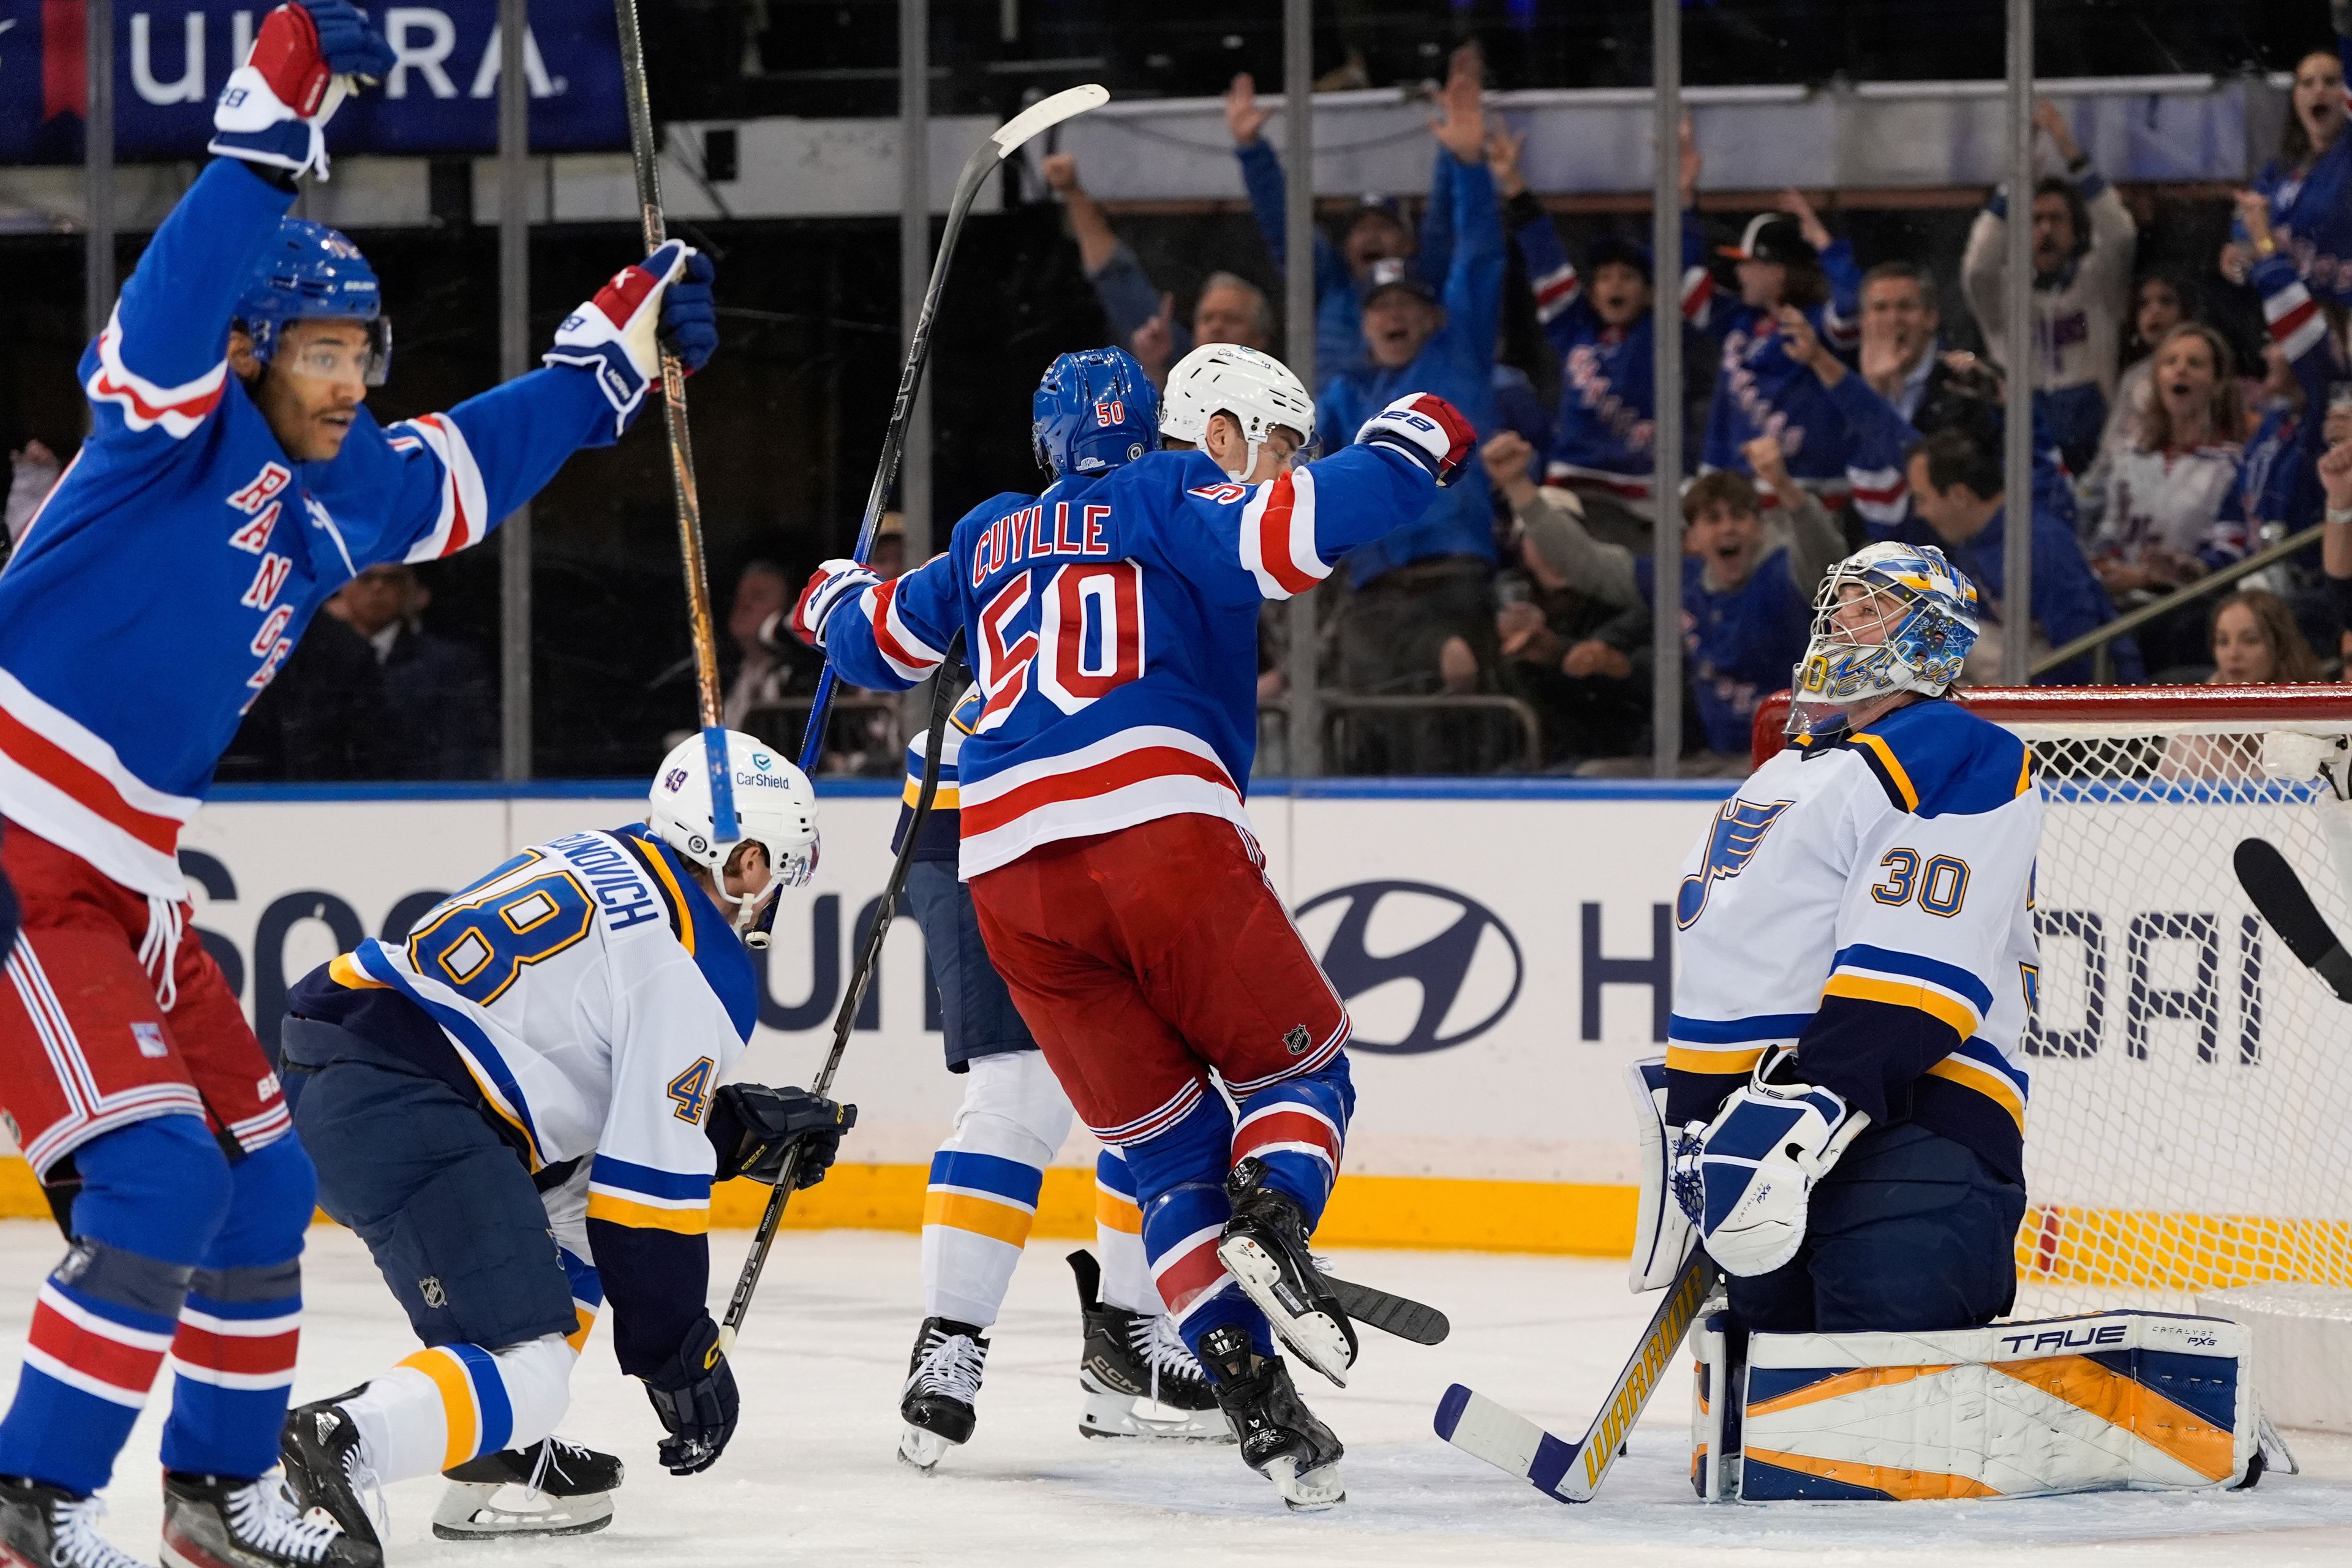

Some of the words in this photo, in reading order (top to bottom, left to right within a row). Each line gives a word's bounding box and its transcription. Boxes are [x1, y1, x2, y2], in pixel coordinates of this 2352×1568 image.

[1095, 400, 1126, 428] 50
[972, 502, 1112, 589] CUYLLE
[976, 556, 1145, 735] 50
[736, 766, 789, 790] CarShield
[1871, 847, 1970, 918] 30
[1292, 1031, 1303, 1052] NHL
[2000, 1324, 2128, 1354] TRUE
[2151, 1325, 2216, 1337] CATALYST
[1092, 1355, 1142, 1394] CCM
[1584, 1264, 1705, 1490] WARRIOR
